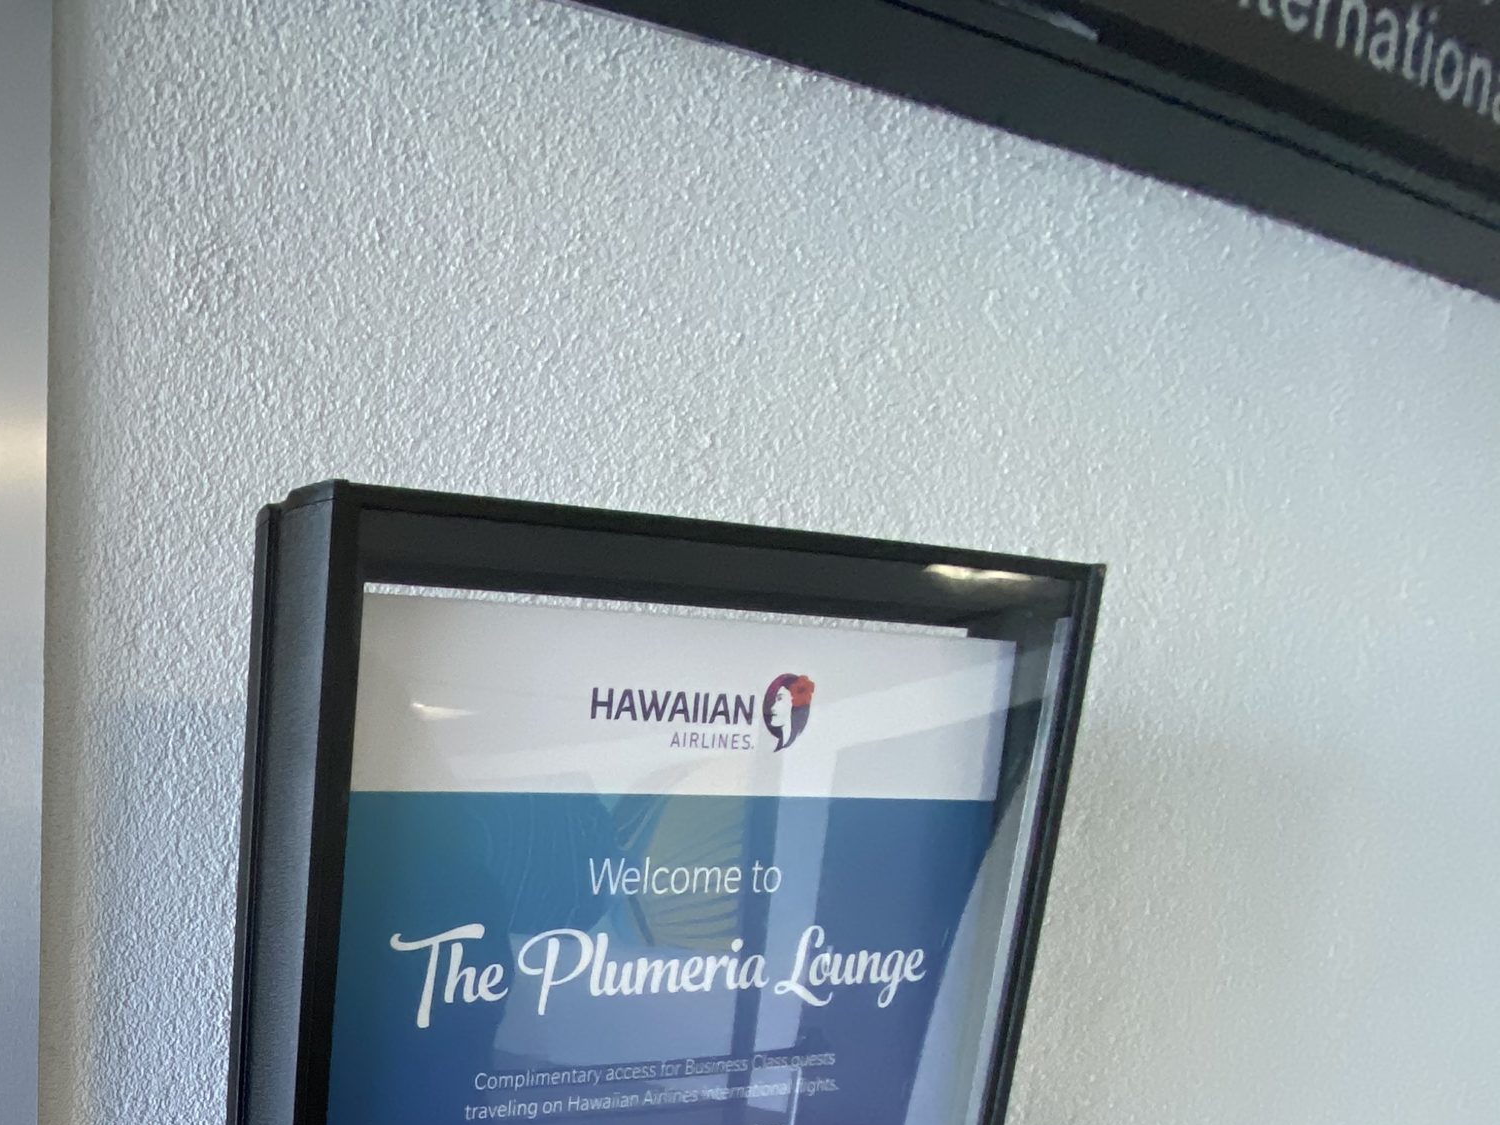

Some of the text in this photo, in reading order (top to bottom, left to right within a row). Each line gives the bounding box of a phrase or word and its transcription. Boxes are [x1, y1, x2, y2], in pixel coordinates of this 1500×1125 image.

[590, 687, 756, 726] HAWAIIAN
[589, 856, 782, 896] Welcome to
[390, 923, 927, 1029] The Plumeria Lounge
[474, 1068, 602, 1092] Complimentary
[605, 1064, 657, 1082] access
[661, 1060, 682, 1077] for
[684, 1058, 749, 1076] Business
[752, 1053, 787, 1070] Class
[464, 1099, 538, 1121] traveling
[542, 1101, 563, 1114] on
[568, 1092, 639, 1113] Hawaiian
[643, 1087, 699, 1106] Airlines
